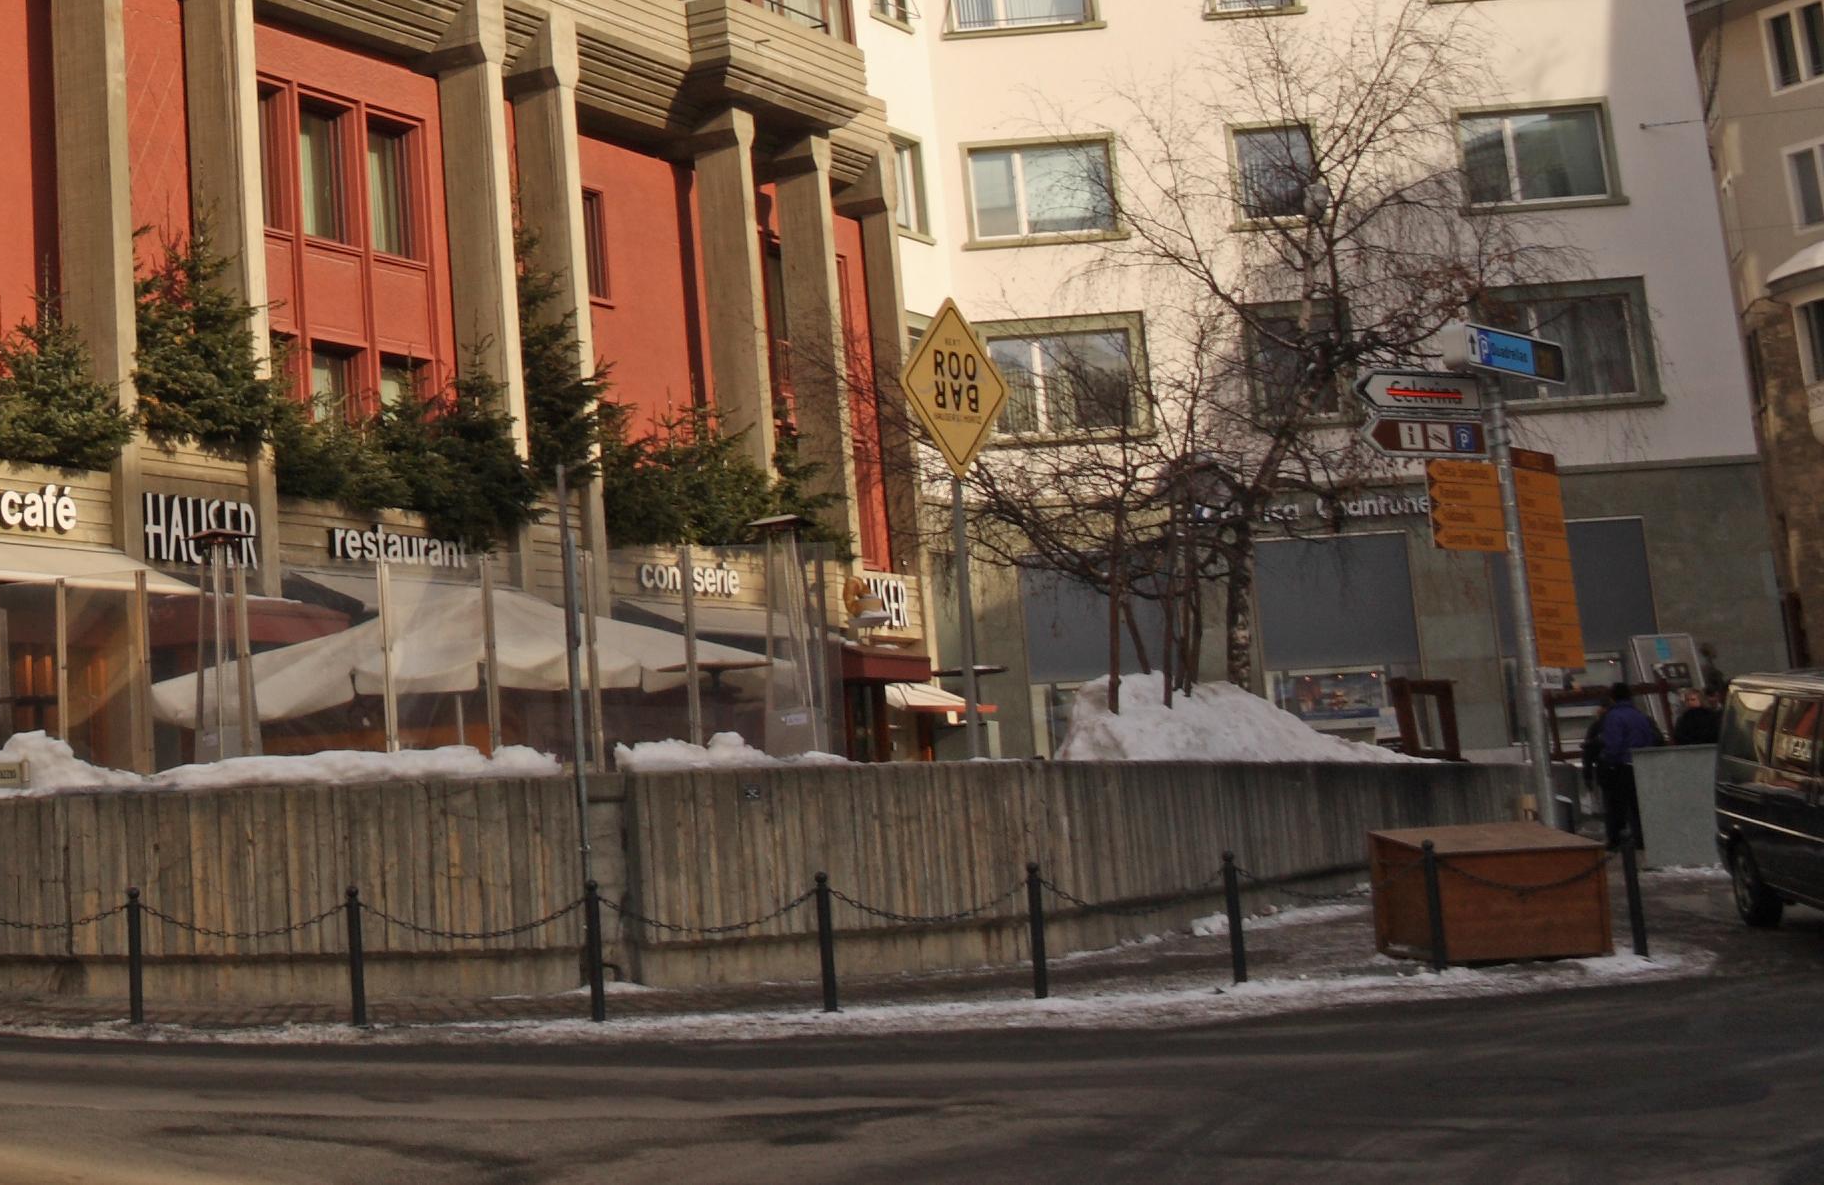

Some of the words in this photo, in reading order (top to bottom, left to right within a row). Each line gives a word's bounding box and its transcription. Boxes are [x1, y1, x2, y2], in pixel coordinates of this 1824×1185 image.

[933, 349, 977, 381] ROO
[934, 380, 979, 413] BAR
[1390, 380, 1463, 405] Celerina
[0, 484, 76, 530] café
[334, 524, 468, 568] restaurant
[641, 562, 740, 594] conserie
